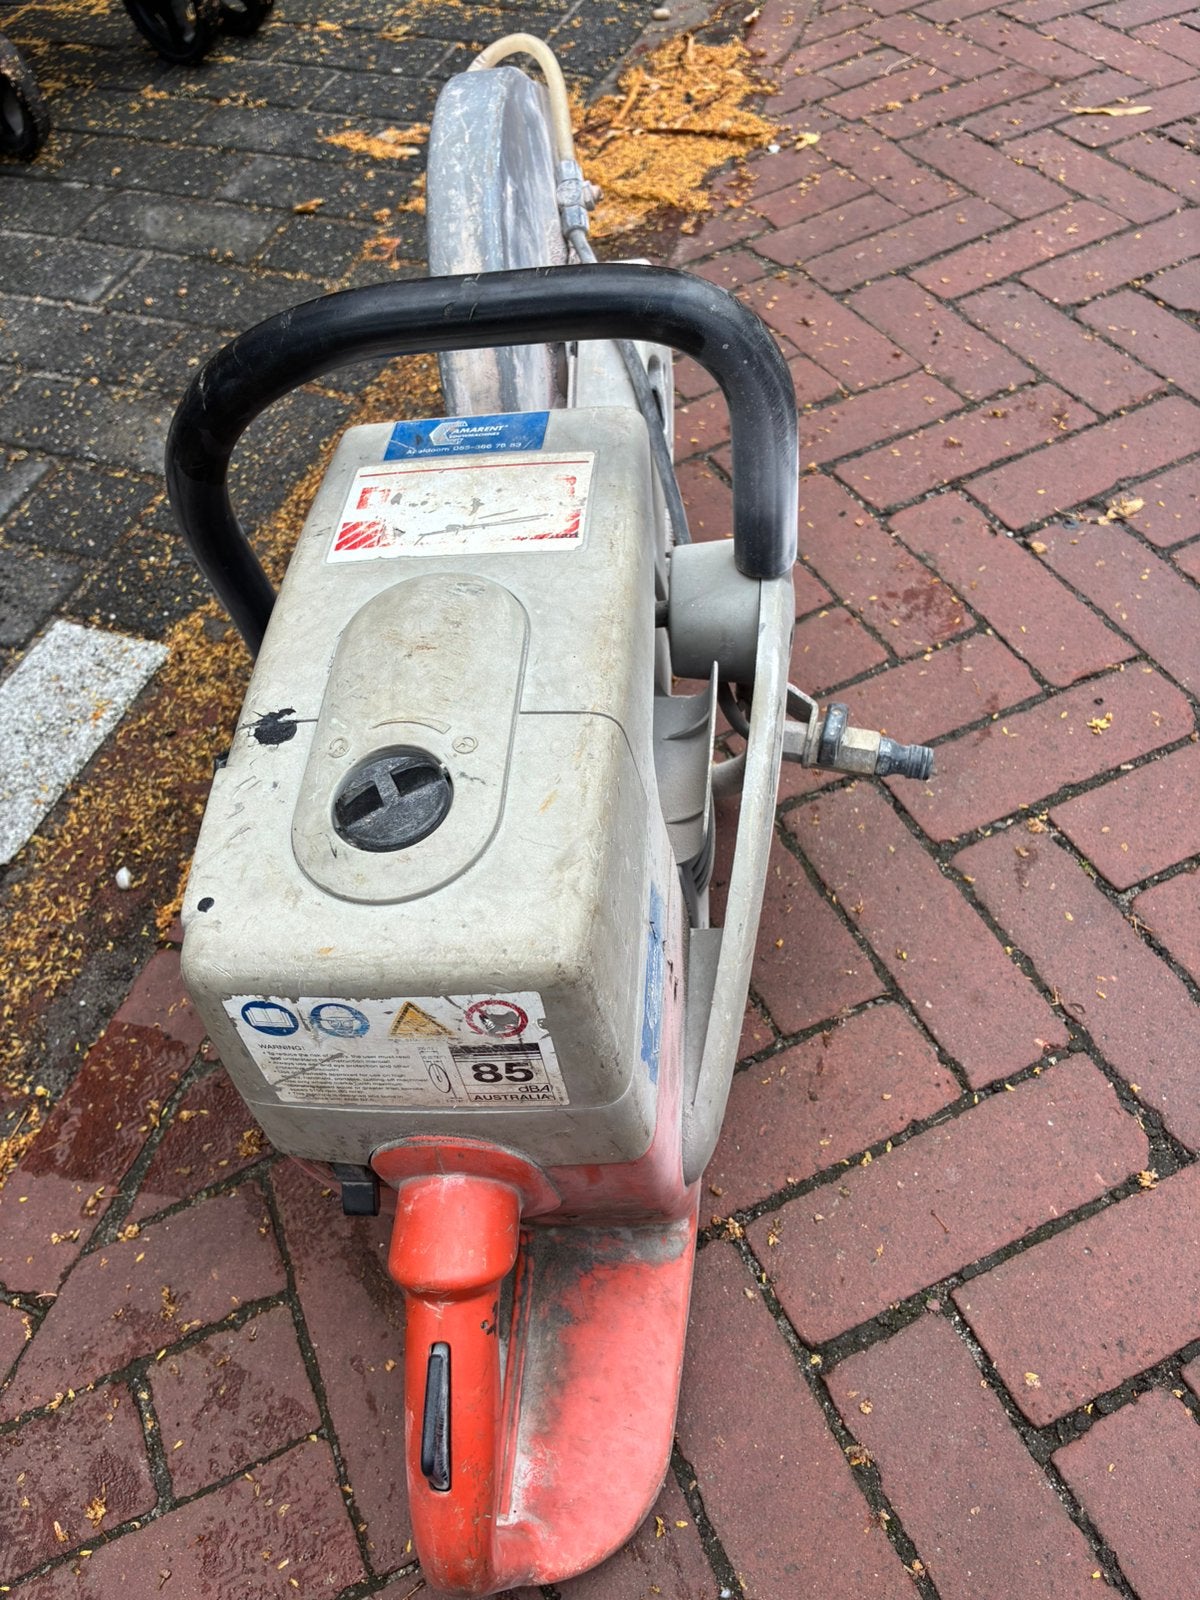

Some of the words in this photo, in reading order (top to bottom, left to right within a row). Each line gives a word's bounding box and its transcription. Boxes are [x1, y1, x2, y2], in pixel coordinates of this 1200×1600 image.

[472, 1062, 534, 1083] 85
[518, 1085, 550, 1093] dBA
[474, 1093, 551, 1101] AUSTRALIA
